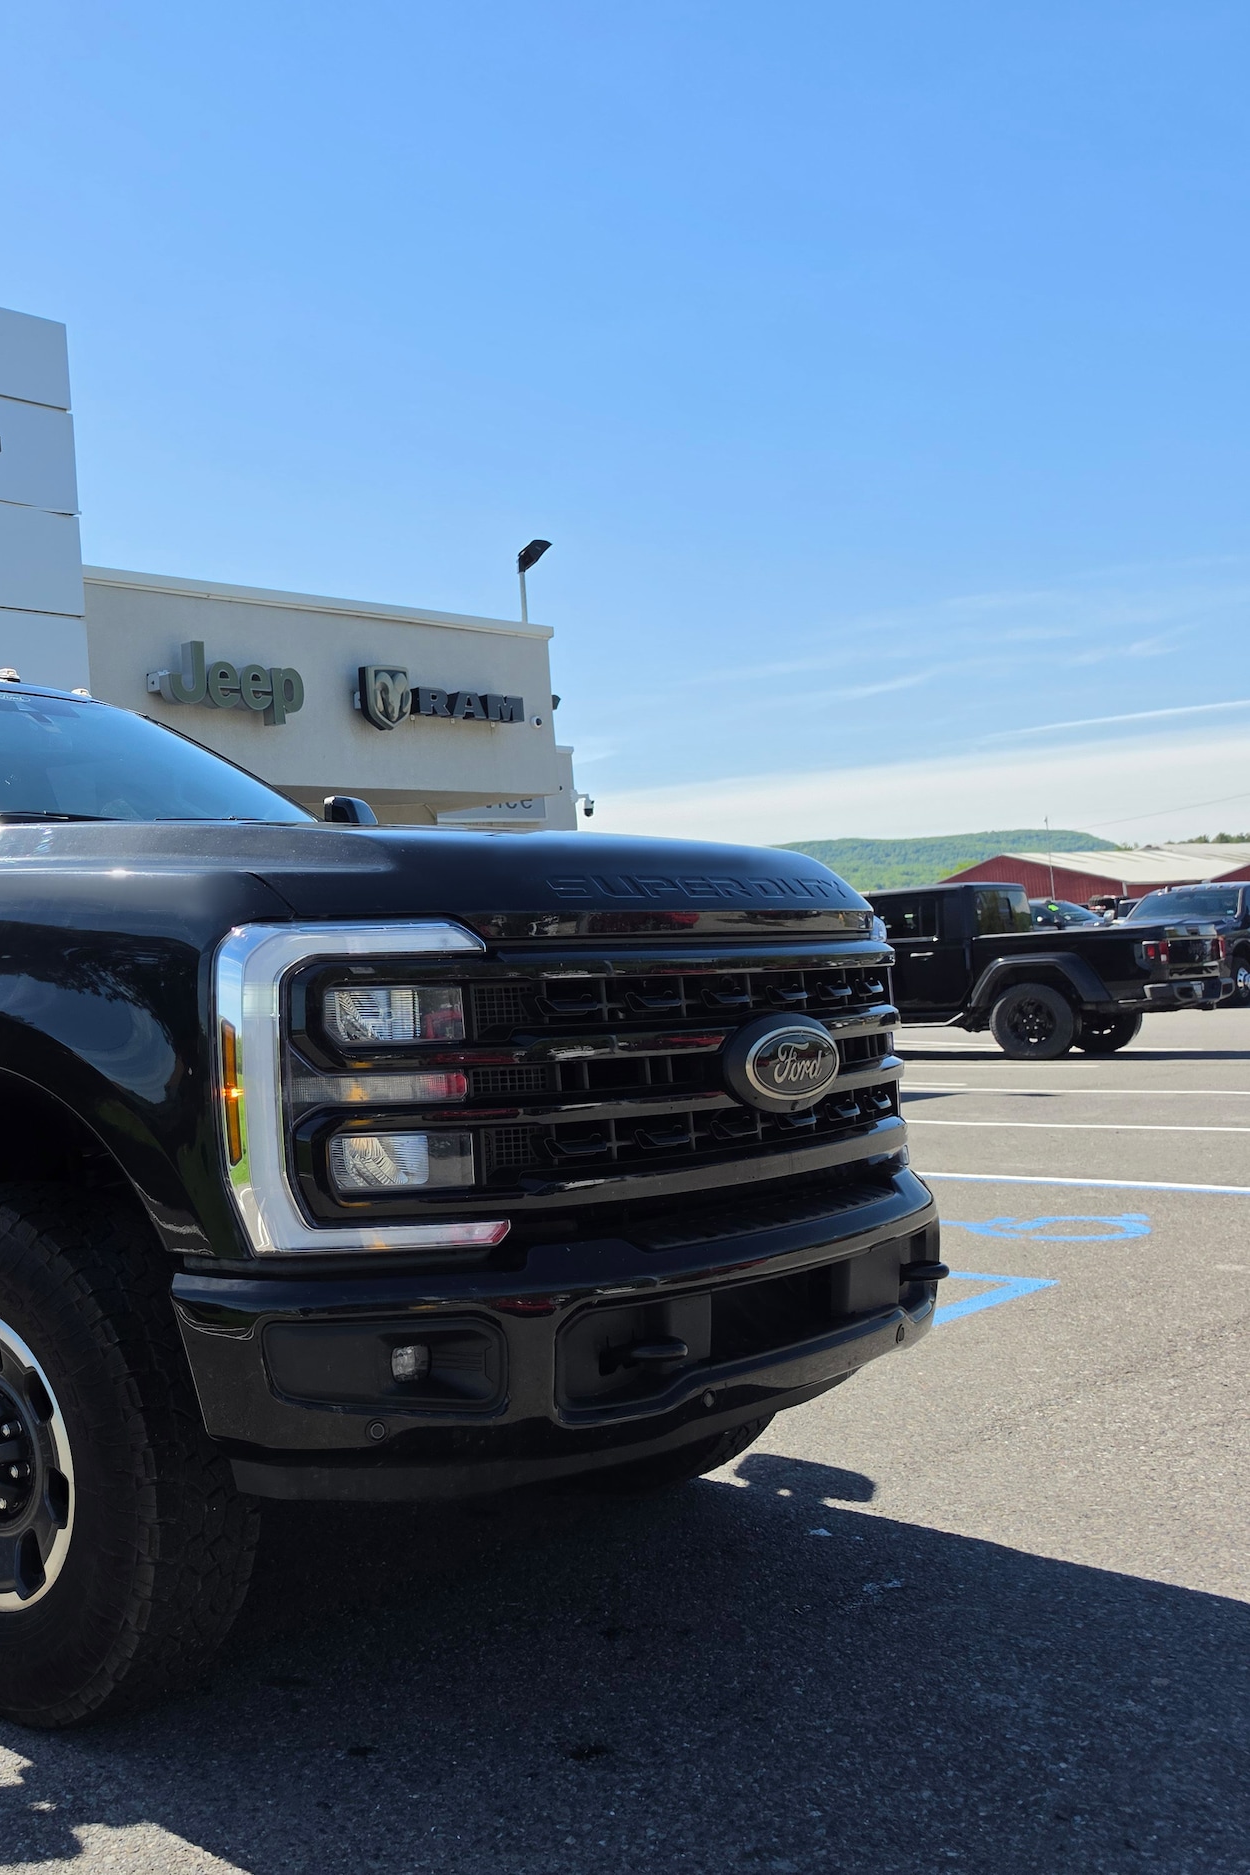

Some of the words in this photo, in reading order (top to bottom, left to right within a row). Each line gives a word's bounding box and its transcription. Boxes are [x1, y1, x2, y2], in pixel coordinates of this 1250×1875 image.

[159, 641, 305, 727] Jeep
[410, 686, 525, 724] RAM
[773, 1042, 823, 1084] Ford
